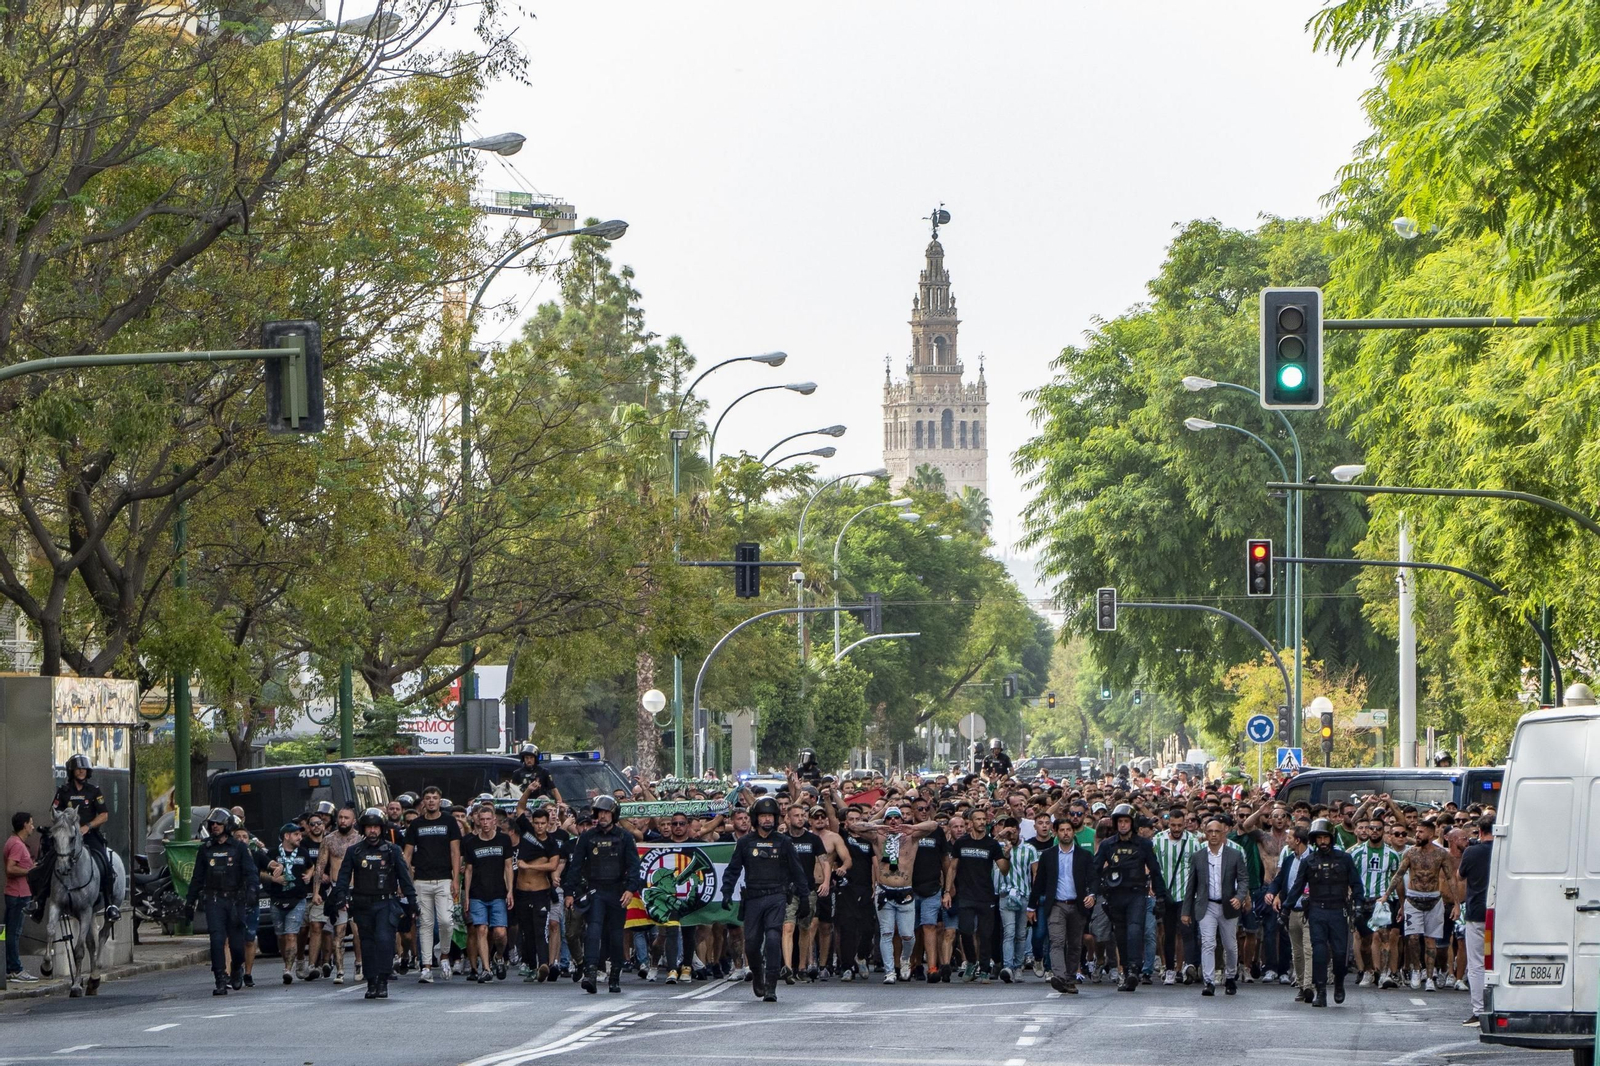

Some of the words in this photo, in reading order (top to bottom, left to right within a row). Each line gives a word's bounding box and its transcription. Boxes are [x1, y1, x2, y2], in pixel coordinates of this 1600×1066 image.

[299, 767, 333, 778] 4U-00
[1515, 966, 1526, 979] ZA
[1530, 966, 1551, 979] 6884
[1555, 966, 1562, 979] K
